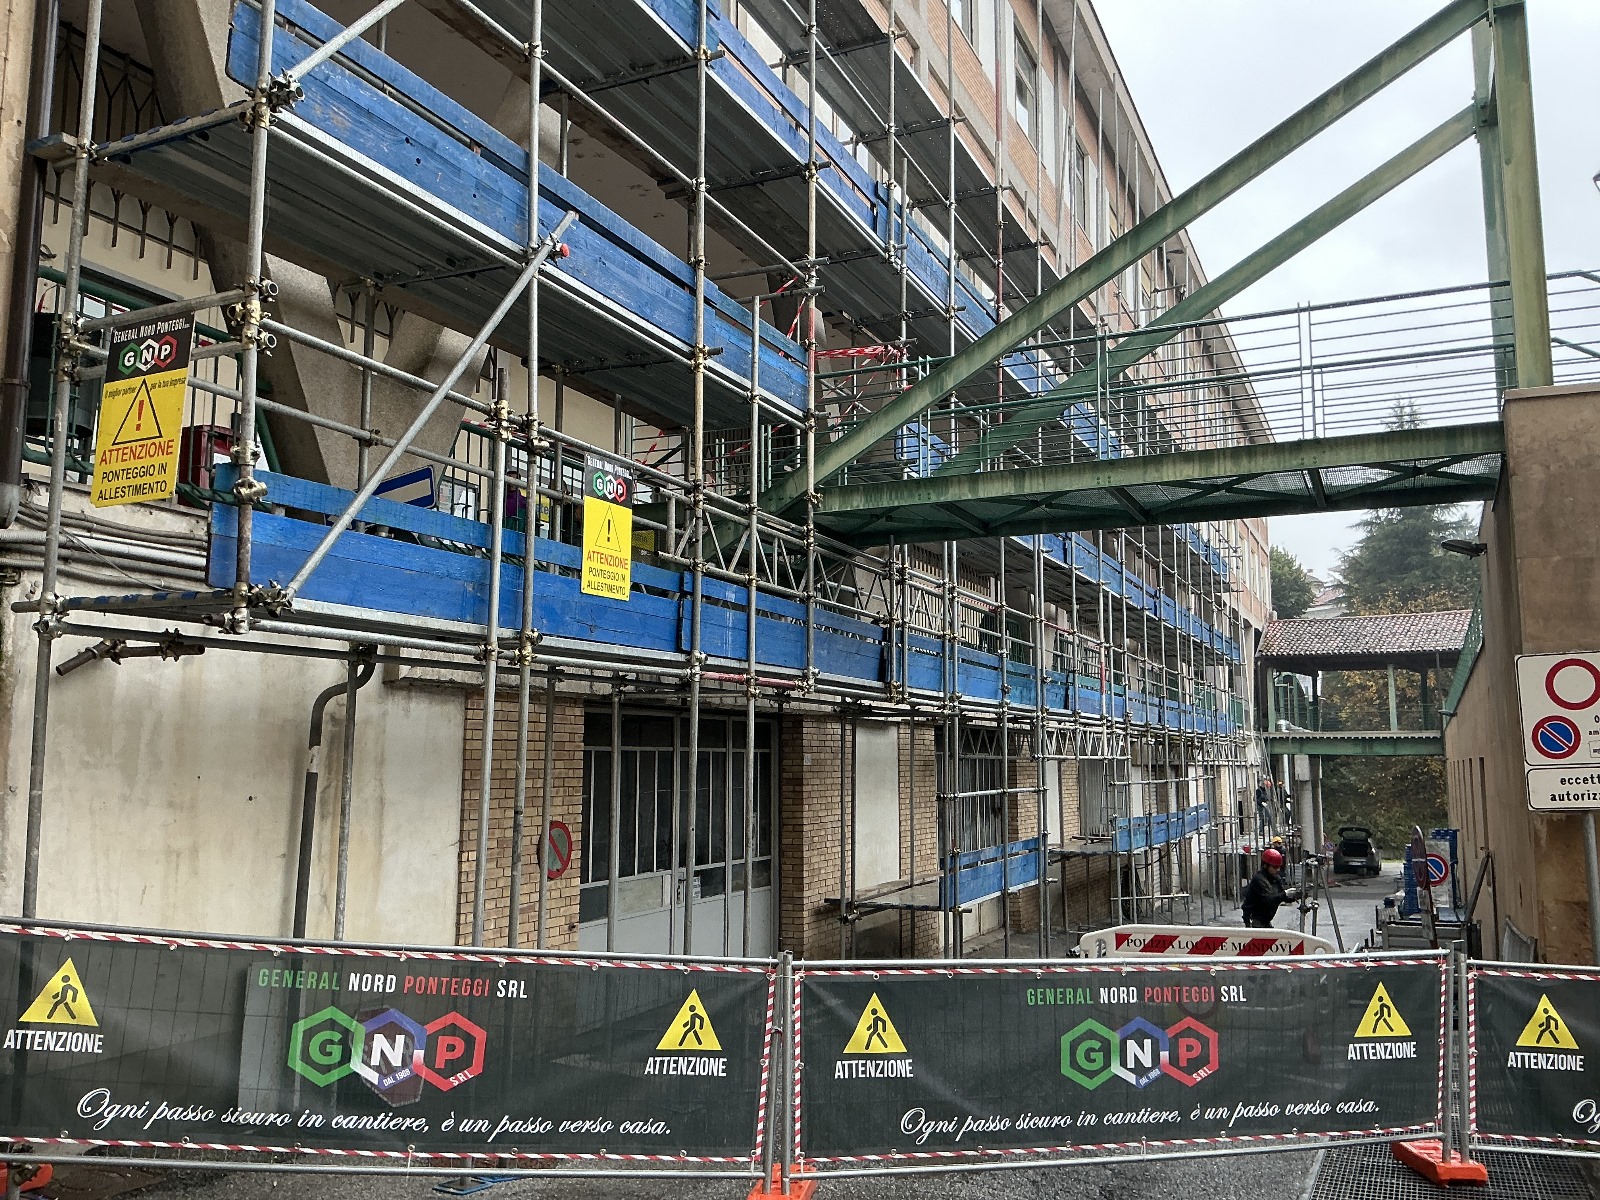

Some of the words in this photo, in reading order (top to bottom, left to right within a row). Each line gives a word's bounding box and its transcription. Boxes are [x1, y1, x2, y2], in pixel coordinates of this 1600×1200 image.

[99, 438, 175, 466] ATTENZIONE
[101, 463, 156, 484] PONTEGGIO
[157, 462, 168, 475] IN
[97, 479, 167, 501] ALLESTIMENTO
[586, 550, 629, 570] ATTENZIONE
[588, 566, 620, 582] PONTEGGIO
[586, 579, 626, 595] ALLESTIMENTO
[1550, 790, 1600, 801] autoriz
[1126, 938, 1175, 949] POLIZIA
[1178, 940, 1228, 950] LOCALE
[1231, 940, 1293, 952] MONDOVÌ
[258, 968, 340, 991] GENERAL
[348, 972, 397, 993] NORD
[403, 975, 490, 997] PONTEGGI
[496, 979, 528, 999] SRL
[1026, 987, 1094, 1005] GENERAL
[1099, 986, 1138, 1004] NORD
[1144, 986, 1215, 1003] PONTEGGI
[1220, 985, 1247, 1002] SRL
[3, 1029, 104, 1053] ATTENZIONE
[1347, 1041, 1417, 1060] ATTENZIONE
[644, 1056, 728, 1077] ATTENZIONE
[834, 1058, 914, 1079] ATTENZIONE
[1507, 1051, 1585, 1072] ATTENZIONE
[449, 1070, 475, 1087] SRL
[1192, 1066, 1213, 1082] SRL
[77, 1087, 151, 1130] Ogni
[143, 1101, 216, 1130] passo
[220, 1106, 292, 1128] sicuro
[297, 1108, 328, 1128] in
[329, 1111, 430, 1133] cantiere,
[440, 1111, 456, 1132] è
[458, 1118, 492, 1133] un
[487, 1114, 554, 1142] passo
[558, 1116, 615, 1134] verso
[619, 1117, 672, 1135] casa.
[900, 1107, 958, 1145] Ogni
[954, 1115, 1011, 1142] passo
[1015, 1112, 1073, 1130] sicuro
[1076, 1110, 1099, 1126] in
[1103, 1106, 1182, 1126] cantiere,
[1190, 1103, 1202, 1121] è
[1204, 1105, 1230, 1120] un
[1228, 1100, 1281, 1127] passo
[1285, 1099, 1332, 1117] verso
[1335, 1098, 1380, 1114] casa.
